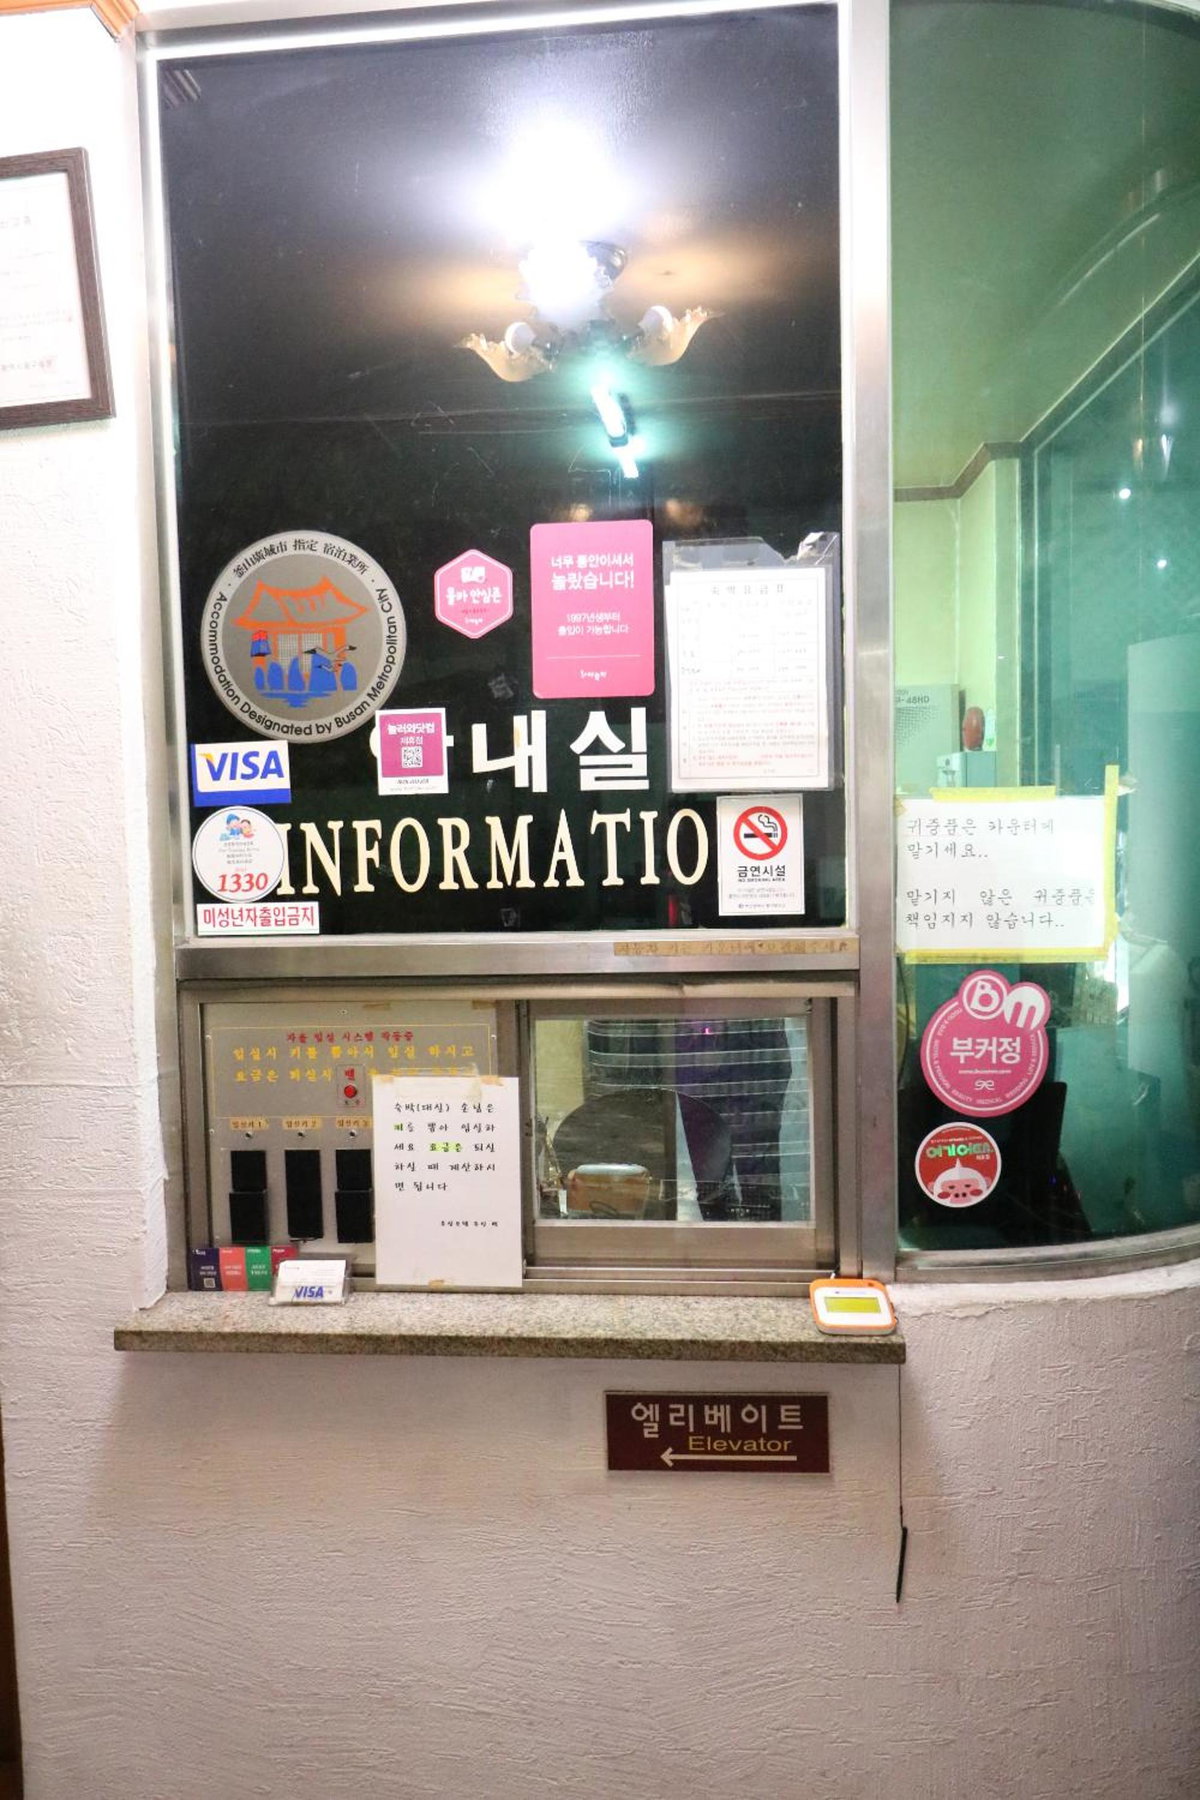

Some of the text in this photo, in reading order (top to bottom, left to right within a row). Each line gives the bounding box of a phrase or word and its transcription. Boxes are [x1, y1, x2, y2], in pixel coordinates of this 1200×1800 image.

[292, 539, 318, 551] 指定
[551, 555, 574, 568] 너무
[551, 570, 635, 590] 놀랐습니다!
[209, 587, 397, 736] Accommodation Designated by Busan Metropolitan City
[369, 707, 650, 792] 내실
[199, 750, 284, 782] VISA
[906, 818, 977, 836] 귀중품은
[276, 807, 708, 896] INFORMATIO
[737, 865, 786, 877] 금연시설
[217, 873, 268, 892] 1330
[980, 888, 1013, 906] 않은
[203, 906, 315, 928] 미성년자출입금지
[905, 912, 974, 931] 책임지지
[950, 1037, 1021, 1065] 부커정
[394, 1143, 414, 1152] 세요
[295, 1286, 324, 1298] VISA
[631, 1402, 803, 1438] 엘리베이트
[688, 1435, 792, 1452] Elevator
